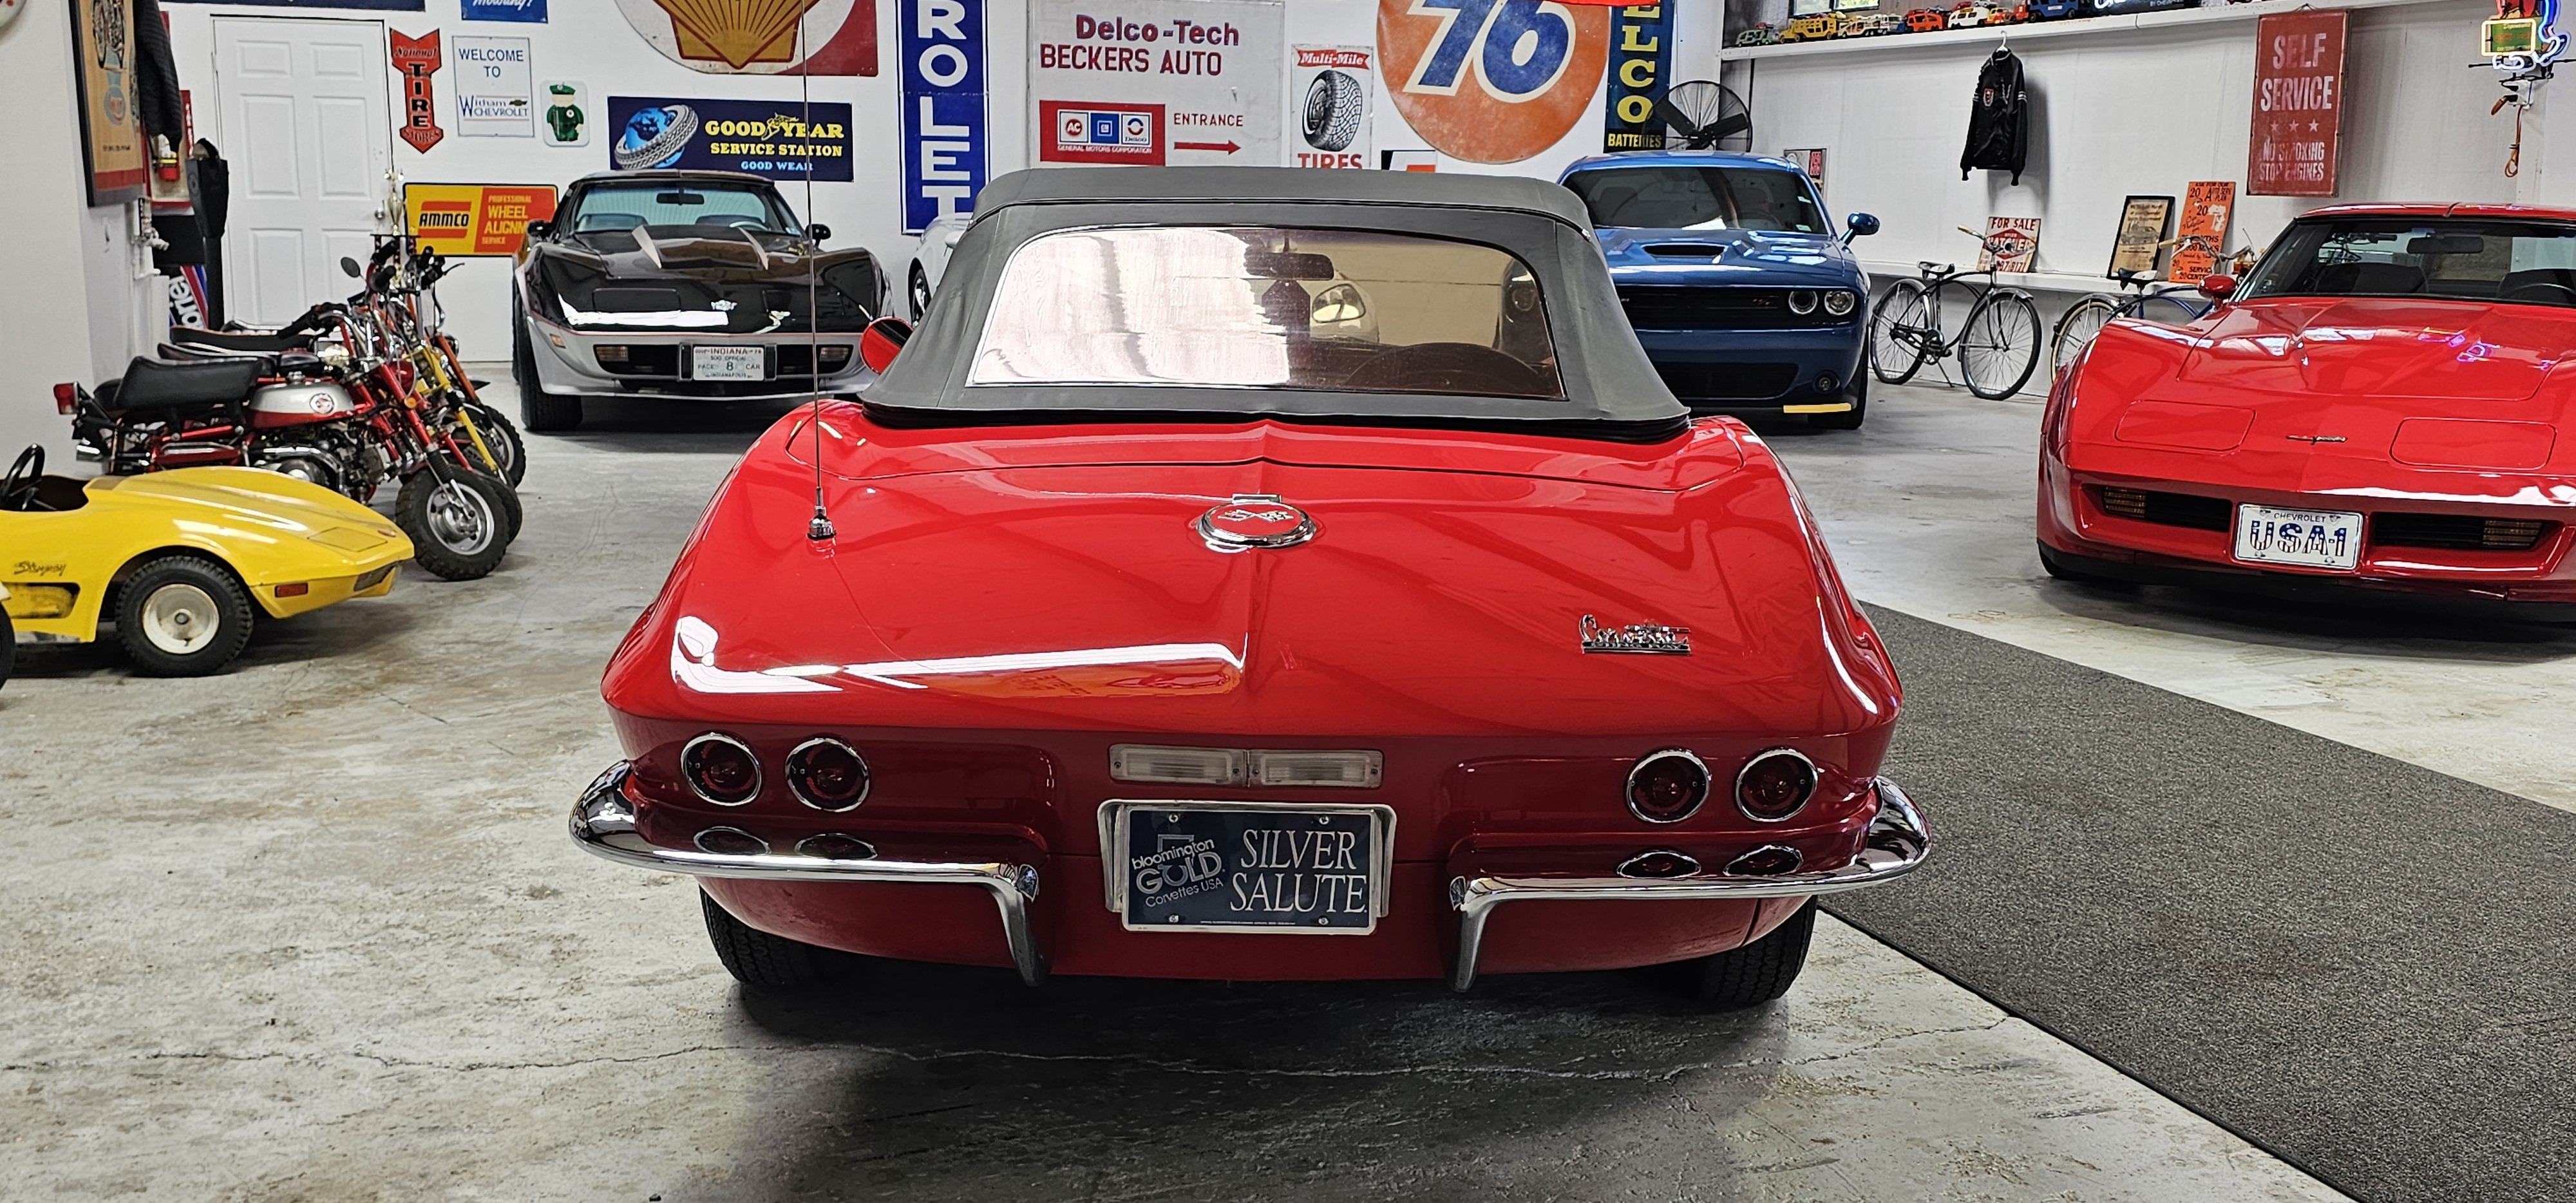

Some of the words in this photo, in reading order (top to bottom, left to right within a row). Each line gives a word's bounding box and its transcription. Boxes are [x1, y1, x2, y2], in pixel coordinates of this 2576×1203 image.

[395, 46, 437, 57] National
[459, 48, 524, 62] WELCOME
[1300, 52, 1365, 65] Multi-Mile
[1403, 0, 1577, 104] 76
[2273, 33, 2327, 69] SELF
[1040, 43, 1150, 72] BECKERS
[1160, 50, 1222, 76] AUTO
[484, 66, 501, 78] TO
[408, 62, 430, 128] TIRE
[2260, 75, 2334, 111] SERVICE
[474, 107, 529, 117] CHEVROLET
[918, 0, 971, 217] ROLET
[1066, 122, 1081, 133] AC
[1173, 113, 1244, 128] ENTRANCE
[403, 128, 440, 144] STORES
[1607, 133, 1662, 147] BATTERIES
[710, 142, 775, 155] SERVICE
[778, 144, 843, 156] STATION
[2261, 142, 2275, 161] NO
[741, 160, 772, 171] GOOD
[777, 161, 813, 171] WEAR
[1298, 153, 1363, 169] TIRES
[2259, 163, 2283, 181] STOP
[488, 205, 528, 218] WHEEL
[2197, 205, 2208, 216] 20
[419, 213, 469, 227] AMMCO
[1991, 218, 2009, 229] FOR
[2013, 218, 2036, 231] SALE
[482, 236, 506, 245] SERVICE
[726, 361, 734, 371] 8
[2274, 513, 2327, 523] CHEVROLET
[2249, 520, 2347, 557] USA-1
[1132, 838, 1215, 869] bloomington
[1240, 829, 1357, 870] SILVER
[1136, 851, 1222, 895] GOLD
[1145, 884, 1200, 907] Corvettes
[1200, 877, 1224, 891] USA
[1229, 872, 1367, 913] SALUTE
